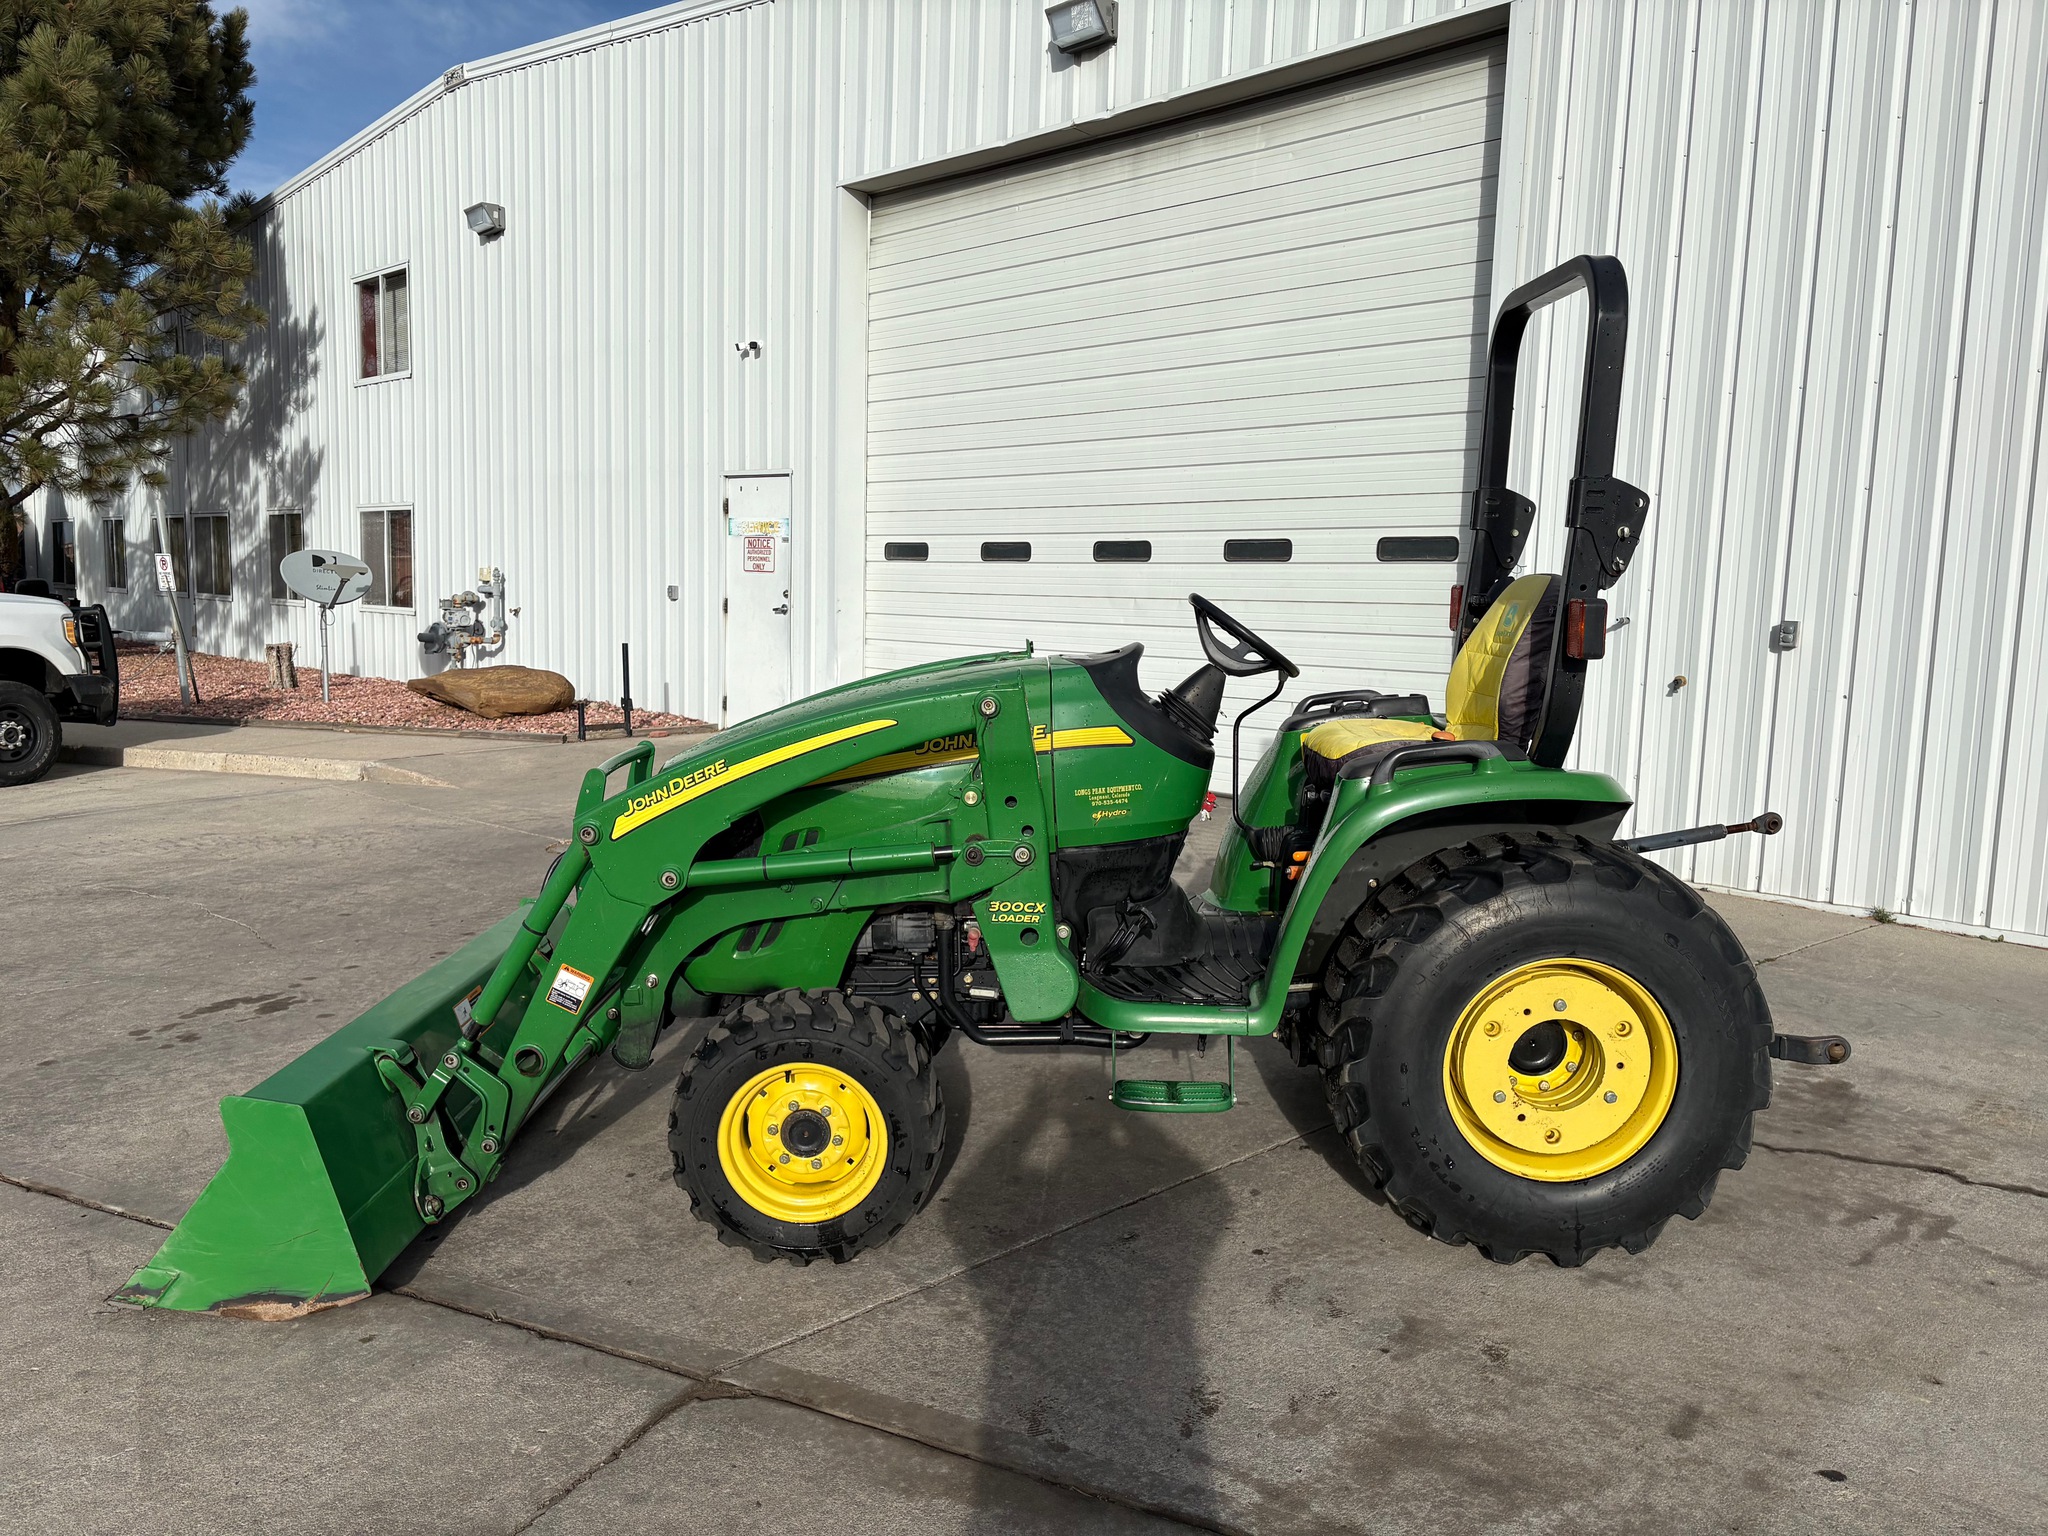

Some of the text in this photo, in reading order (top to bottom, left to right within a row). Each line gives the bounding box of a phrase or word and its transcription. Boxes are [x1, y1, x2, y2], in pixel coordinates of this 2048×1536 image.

[747, 538, 771, 548] NOTICE
[752, 562, 765, 570] ONLY
[915, 733, 974, 754] JOHN
[623, 758, 731, 818] JOHN DEERE
[1074, 788, 1092, 797] LONGS
[1092, 786, 1106, 795] PEAK
[1107, 784, 1135, 794] EQUIPMENT
[988, 901, 1047, 914] 300CX
[991, 913, 1041, 924] LOADER
[570, 969, 591, 981] WARNING
